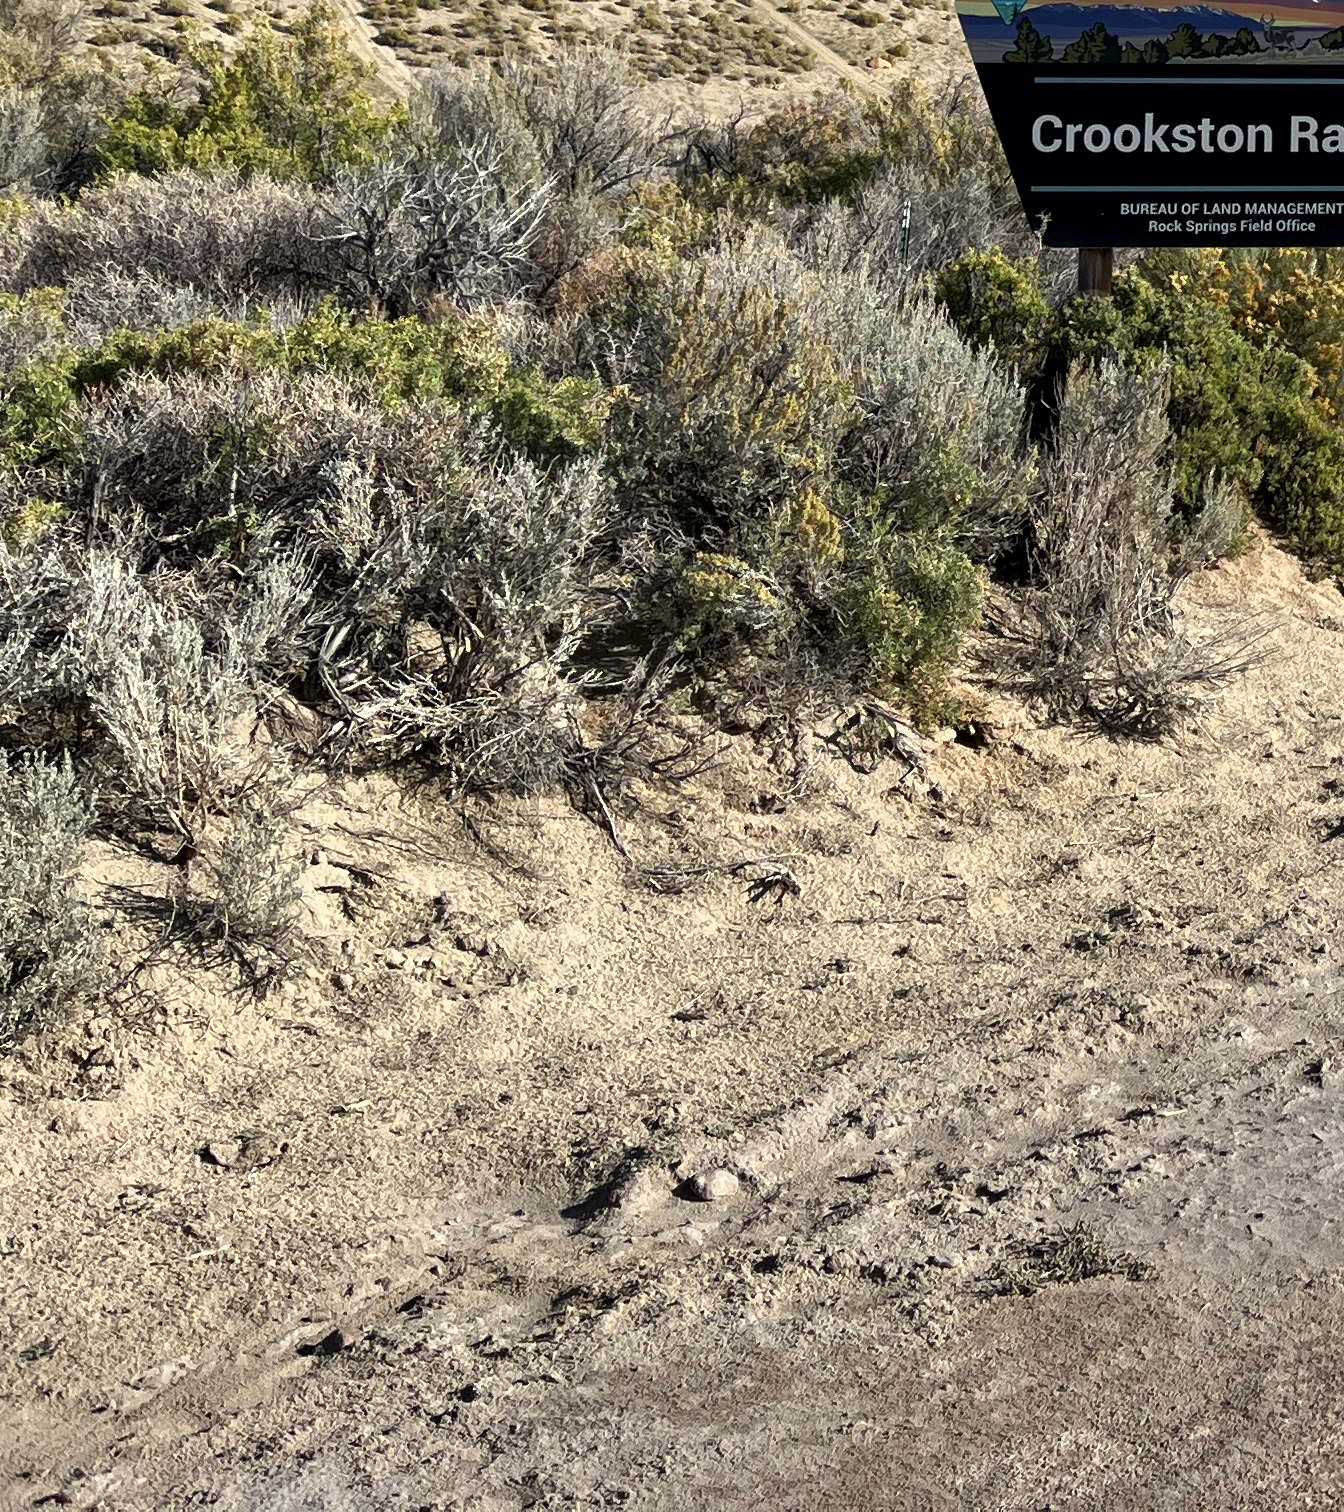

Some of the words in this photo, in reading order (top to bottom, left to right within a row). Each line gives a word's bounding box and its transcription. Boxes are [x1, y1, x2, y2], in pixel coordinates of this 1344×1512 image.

[1031, 112, 1273, 153] Crookston
[1120, 202, 1178, 215] BUREAU
[1181, 202, 1201, 215] OF
[1203, 202, 1242, 215] LAND
[1244, 202, 1344, 215] MANAGEMENT
[1148, 218, 1183, 233] Rock
[1185, 218, 1237, 236] Springs
[1240, 218, 1273, 232] Field
[1275, 218, 1316, 232] Office
